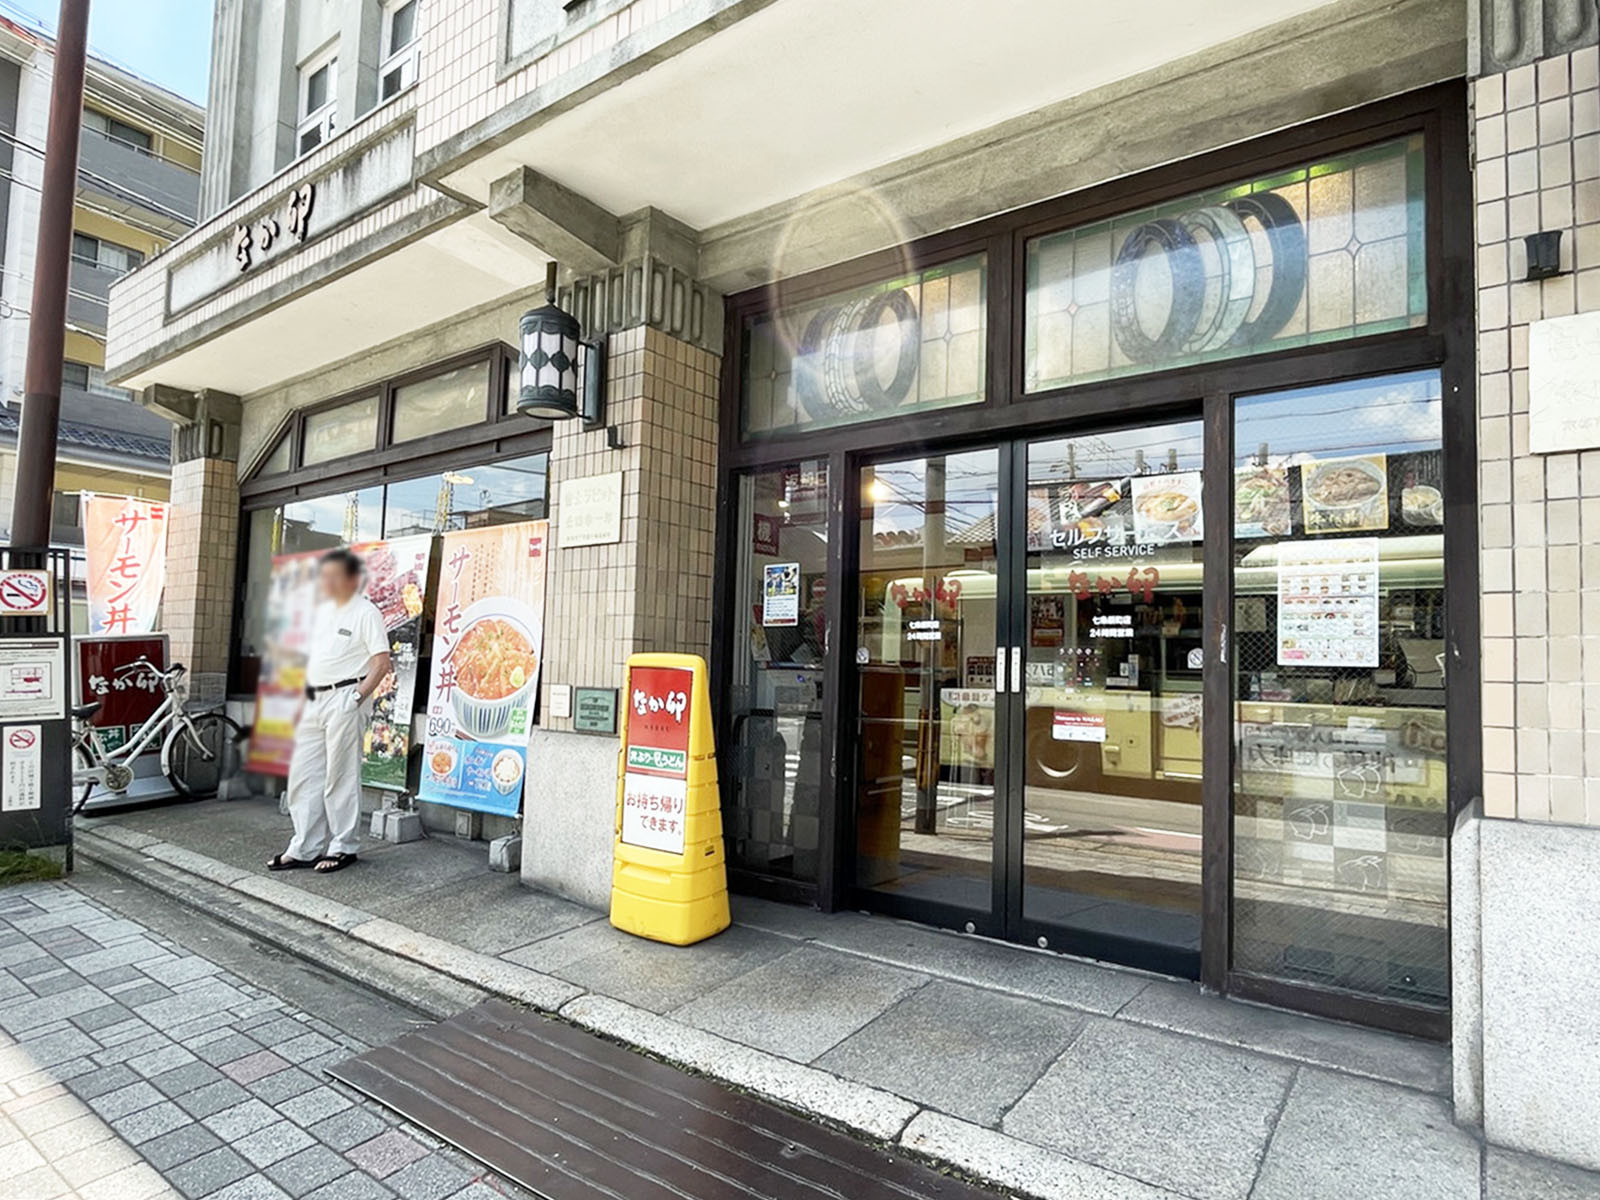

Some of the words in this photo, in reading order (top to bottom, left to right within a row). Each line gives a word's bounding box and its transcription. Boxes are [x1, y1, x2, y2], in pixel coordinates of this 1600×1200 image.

[236, 183, 316, 272] なか卯
[1073, 547, 1101, 560] SELF
[1103, 544, 1155, 558] SERVICE
[103, 510, 148, 635] サーモン丼
[1068, 567, 1159, 603] なか卯
[436, 547, 471, 702] サーモン丼
[88, 672, 160, 695] なか卯
[633, 688, 688, 723] なか卯
[429, 716, 452, 734] 690
[626, 792, 684, 815] お持ち帰り
[640, 813, 683, 836] できます。
